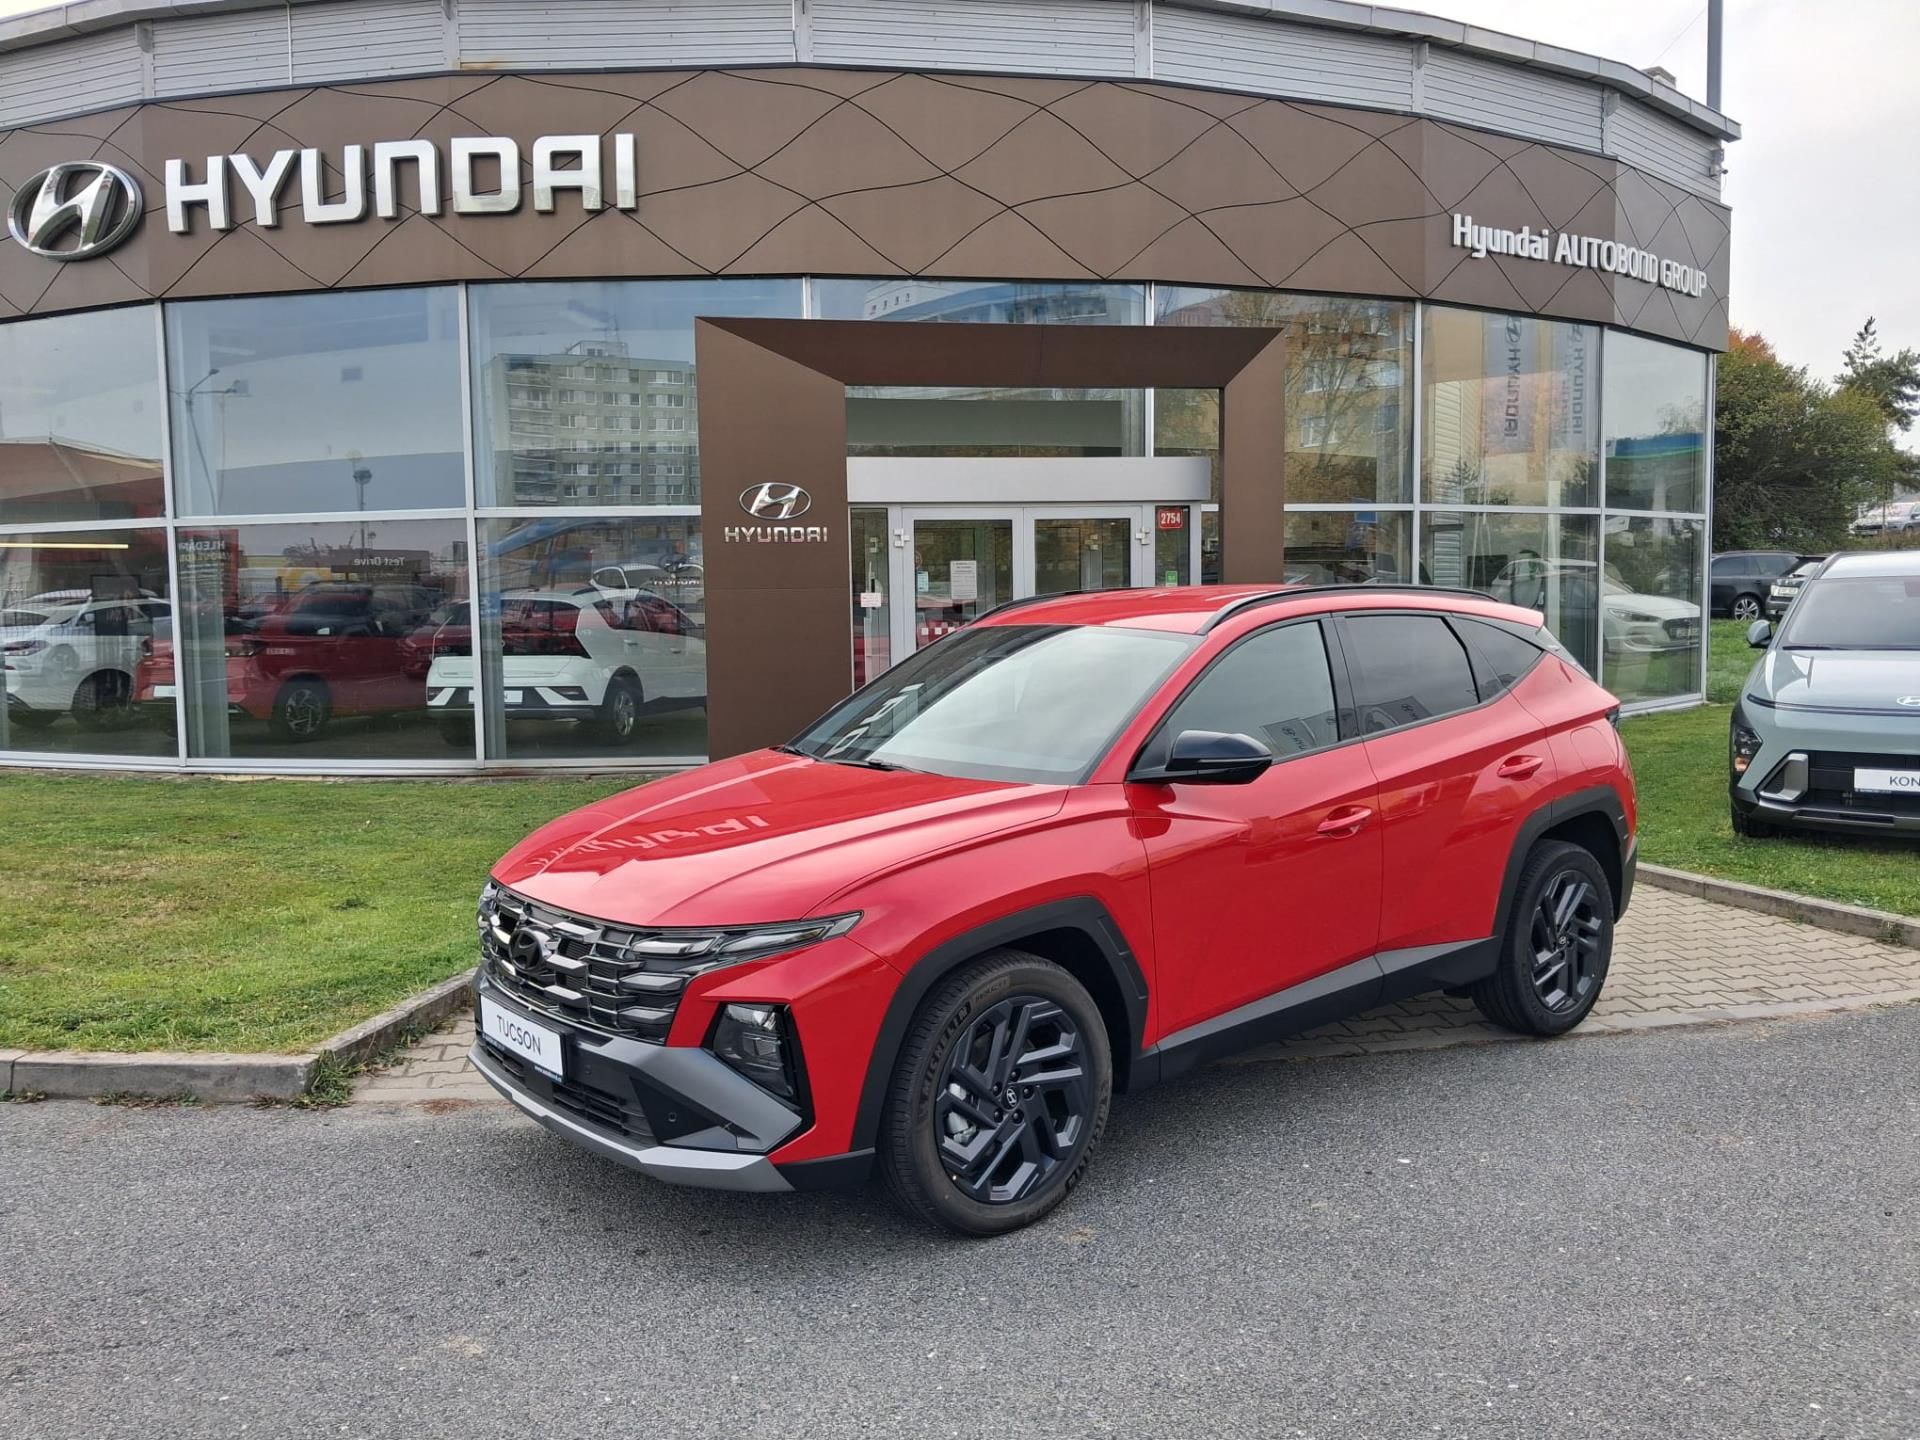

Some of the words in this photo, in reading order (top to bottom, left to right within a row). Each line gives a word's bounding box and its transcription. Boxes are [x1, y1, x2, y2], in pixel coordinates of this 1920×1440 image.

[164, 132, 638, 235] HYUNDAI
[1453, 213, 1549, 260] Hyundai
[1554, 232, 1658, 283] AUTOBOND
[1660, 258, 1707, 298] GROUP
[723, 525, 829, 544] HYUNDAI
[1160, 511, 1181, 525] 2754
[496, 1013, 542, 1056] TUCSON
